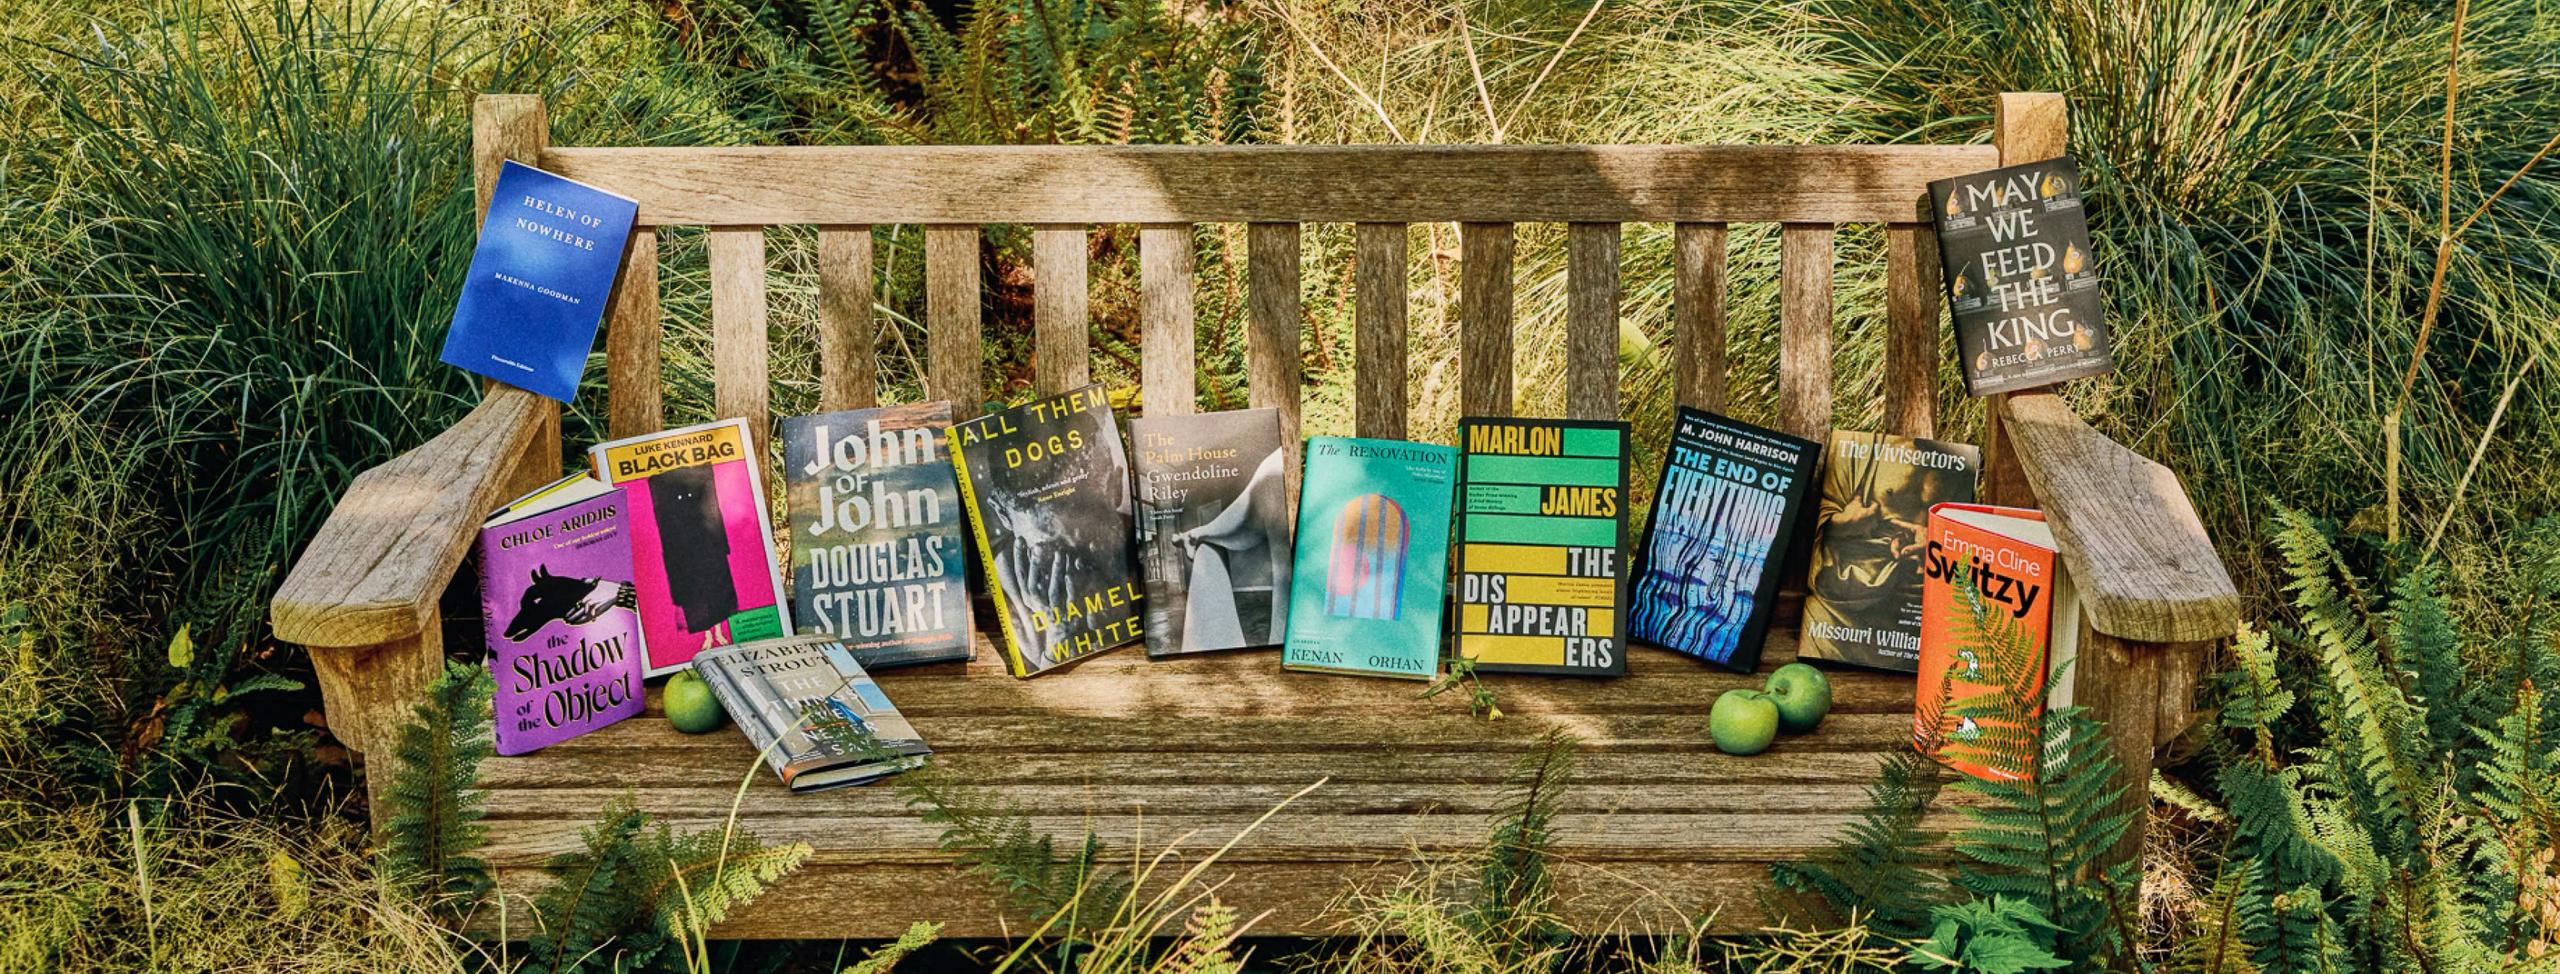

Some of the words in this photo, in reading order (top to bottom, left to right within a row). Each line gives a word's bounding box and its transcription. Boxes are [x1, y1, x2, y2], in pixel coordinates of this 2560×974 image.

[1965, 171, 2041, 212] MAY
[524, 195, 577, 220] HELEN
[580, 214, 602, 228] OF
[1985, 208, 2039, 243] WE
[516, 218, 595, 251] NOWHERE
[1980, 242, 2056, 281] FEED
[495, 272, 535, 290] MAKENNA
[537, 286, 581, 304] GOODMAN
[1993, 276, 2059, 313] THE
[1987, 308, 2075, 350] KING
[1992, 352, 2043, 369] REBECCA
[2047, 343, 2081, 358] PERRY
[963, 415, 1018, 446] ALL
[1031, 387, 1106, 424] THEM
[635, 444, 662, 456] LUKE
[664, 433, 713, 449] KENNARD
[804, 419, 936, 476] John
[1005, 429, 1084, 469] DOGS
[1145, 432, 1175, 447] The
[1146, 450, 1183, 465] Palm
[1187, 446, 1237, 461] House
[1319, 444, 1340, 456] The
[1350, 445, 1448, 464] RENOVATION
[1469, 424, 1561, 456] MARLON
[1681, 423, 1696, 436] M.
[1698, 428, 1733, 447] JOHN
[1735, 438, 1799, 465] HARRISON
[1839, 439, 1870, 459] The
[1873, 443, 1966, 472] Vivisectors
[619, 449, 690, 476] BLACK
[693, 442, 735, 463] BAG
[1146, 465, 1239, 484] Gwendoline
[1673, 446, 1713, 472] THE
[1714, 457, 1758, 484] END
[1760, 472, 1792, 493] OF
[836, 473, 870, 494] OF
[1149, 485, 1188, 502] Riley
[808, 480, 941, 536] John
[1541, 486, 1617, 517] JAMES
[1657, 464, 1787, 542] EVERYTHING
[501, 523, 554, 549] CHLOE
[560, 504, 616, 532] ARIDJIS
[809, 536, 944, 589] DOUGLAS
[1568, 547, 1615, 577] THE
[1943, 530, 1994, 564] Emma
[1998, 547, 2040, 577] Cline
[1464, 574, 1505, 603] DIS
[1926, 541, 2040, 618] Switzy
[813, 582, 946, 639] STUART
[1032, 582, 1144, 632] DJAMEL
[1489, 604, 1586, 636] APPEAR
[547, 635, 568, 649] the
[1051, 616, 1143, 663] WHITE
[1808, 621, 1872, 644] Missouri
[512, 632, 627, 694] Shadow
[714, 641, 837, 665] ELIZABETH
[741, 656, 830, 677] STROUT
[1291, 649, 1344, 663] KENAN
[1369, 655, 1424, 670] ORHAN
[1566, 637, 1613, 668] ERS
[544, 671, 632, 728] Object
[780, 677, 822, 692] THE
[516, 700, 534, 717] of
[518, 718, 541, 732] the
